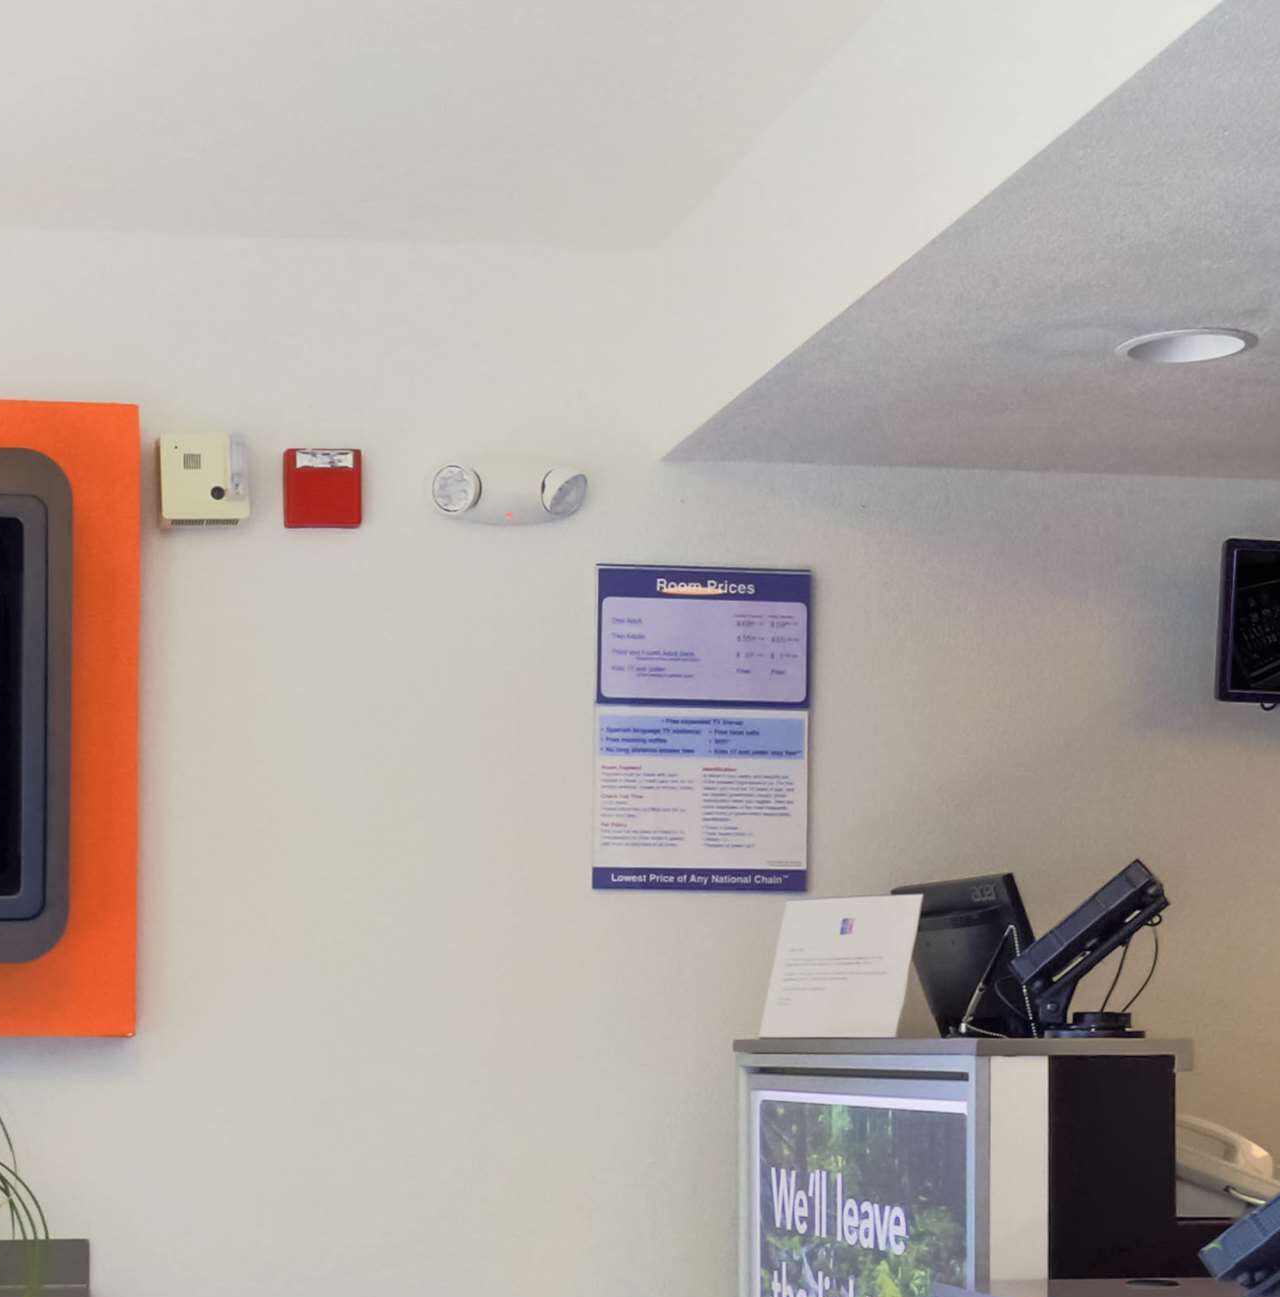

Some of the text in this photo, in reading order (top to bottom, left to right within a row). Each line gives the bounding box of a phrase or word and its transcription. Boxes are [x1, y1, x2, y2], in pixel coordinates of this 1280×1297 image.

[656, 578, 755, 595] Room Prices
[611, 872, 647, 882] Lowest
[649, 873, 674, 883] Price
[677, 873, 687, 883] of
[689, 874, 708, 885] Any
[712, 874, 752, 884] National
[770, 1166, 907, 1255] We'll leave
